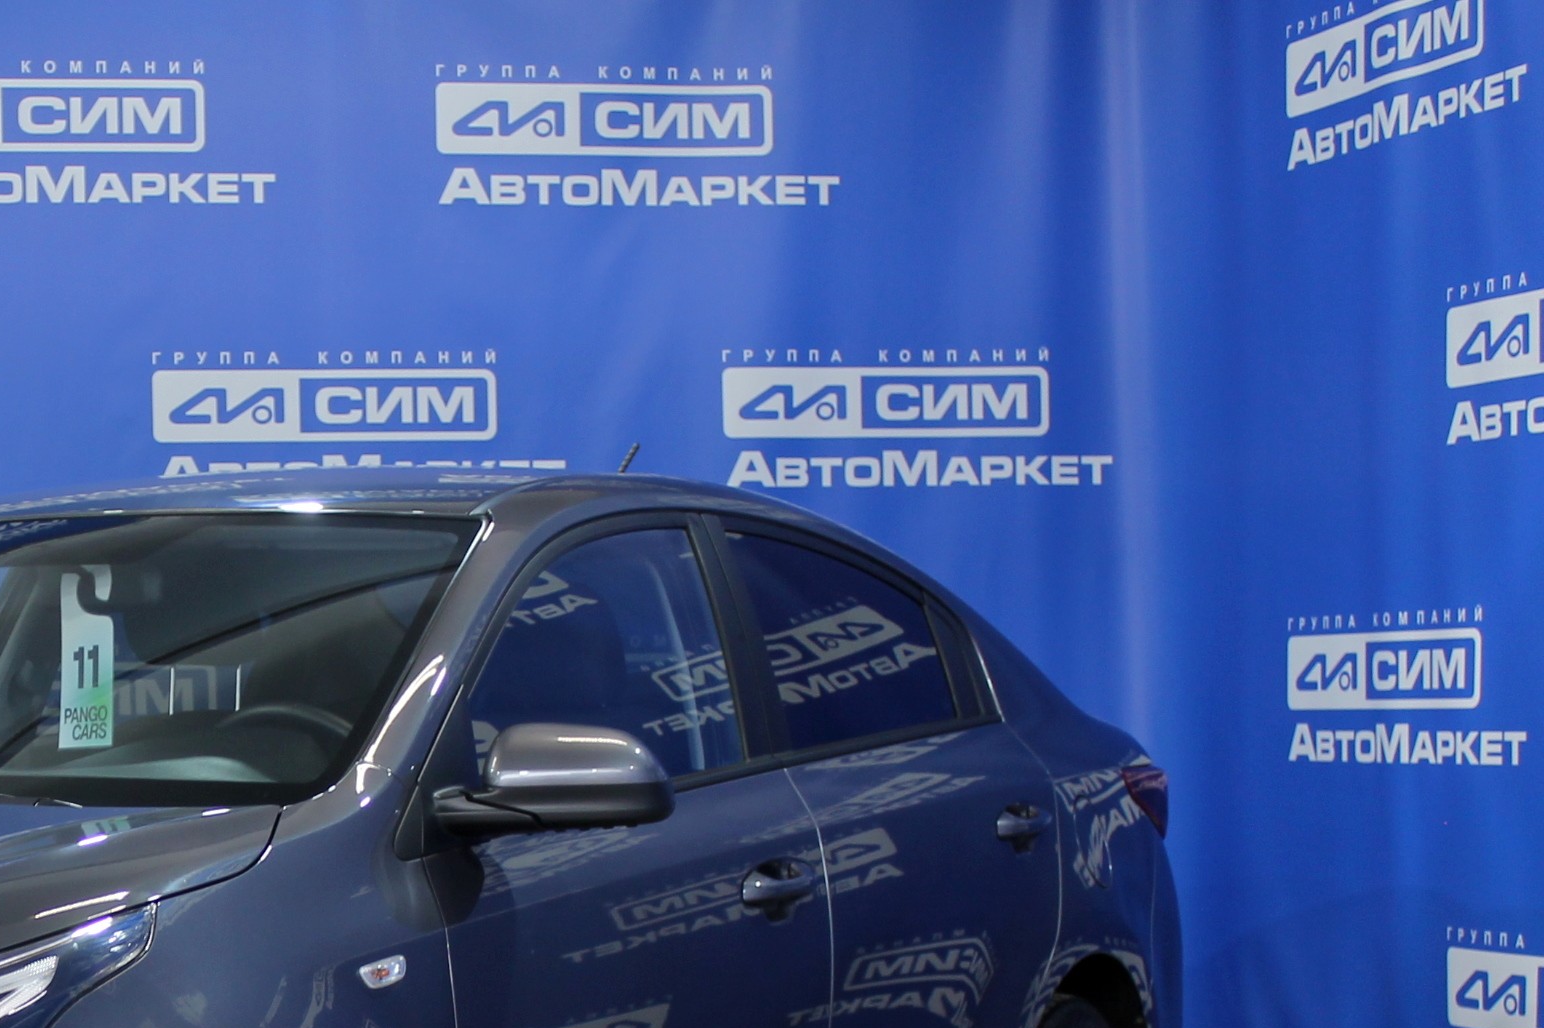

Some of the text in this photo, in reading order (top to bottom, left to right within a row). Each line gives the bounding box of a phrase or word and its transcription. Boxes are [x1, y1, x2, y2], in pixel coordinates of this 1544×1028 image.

[1285, 2, 1355, 39] ГРУППА
[1370, 0, 1470, 69] СИМ
[20, 58, 205, 75] КОМПАНИЙ
[435, 63, 773, 82] ГРУППА КОМПАНИЙ
[17, 95, 182, 135] СИМ
[594, 100, 751, 140] СИМ
[1446, 271, 1528, 303] ГРУППА
[151, 348, 497, 365] ГРУППА КОМПАНИЙ
[720, 346, 1050, 364] ГРУППА КОМПАНИЙ
[314, 385, 475, 424] СИМ
[875, 382, 1029, 421] СИМ
[1287, 604, 1484, 632] ГРУППА КОМПАНИЙ
[73, 645, 99, 689] 11
[1372, 647, 1467, 691] СИМ
[64, 705, 108, 724] PANGO
[72, 723, 107, 740] CARS
[1446, 926, 1525, 949] ГРУППА
